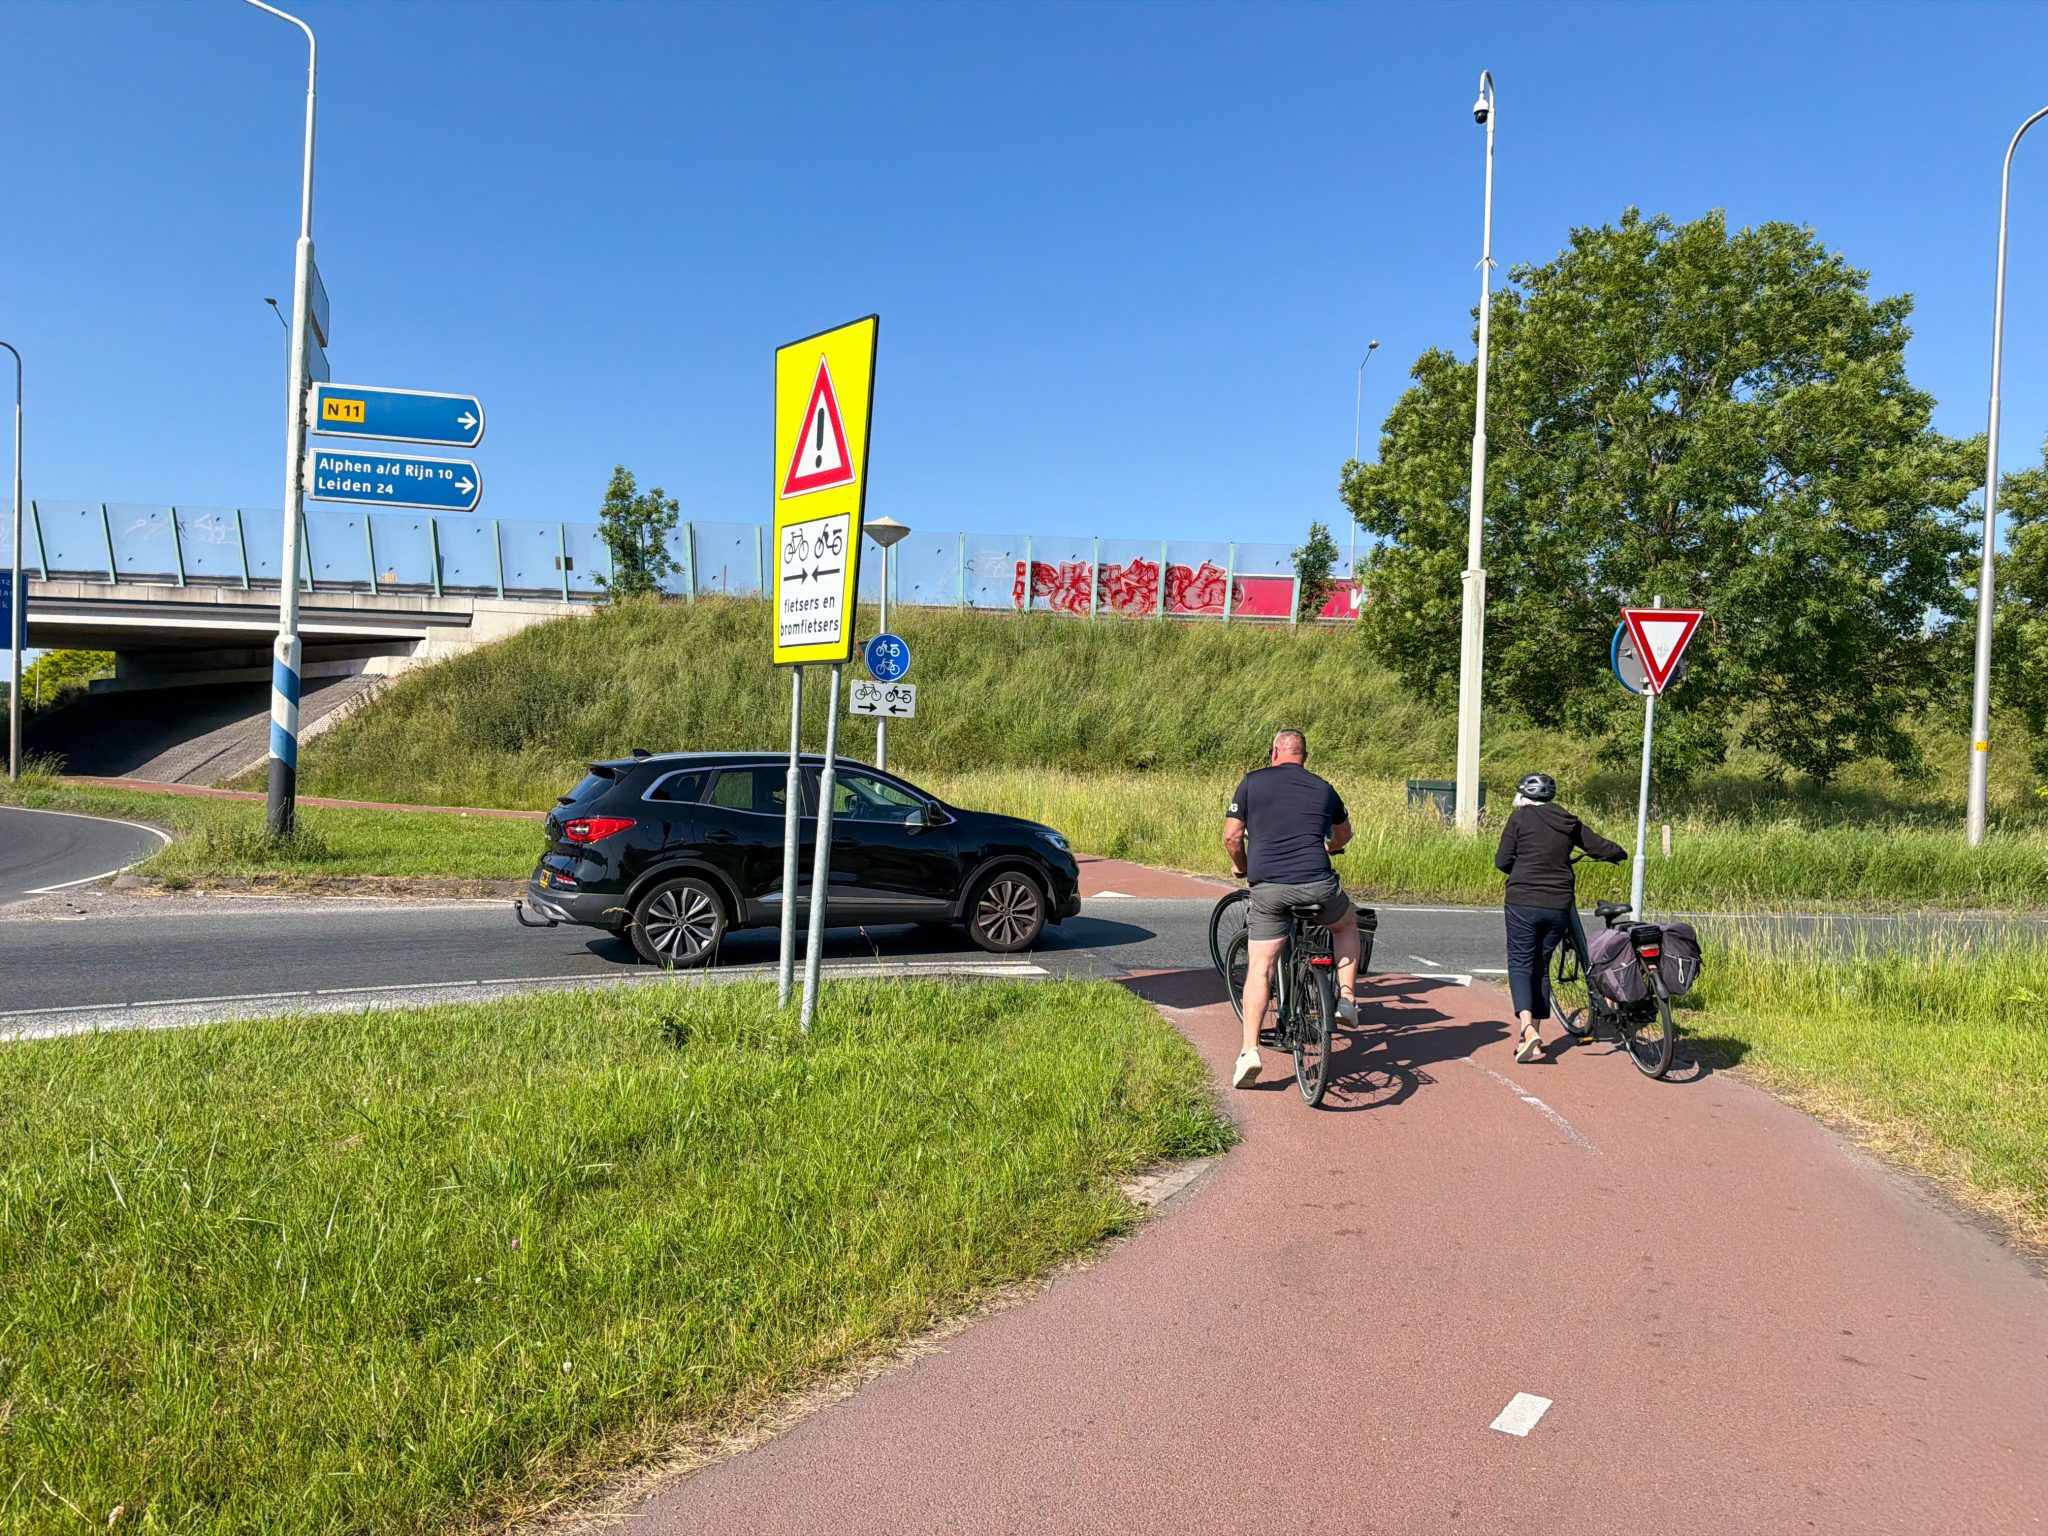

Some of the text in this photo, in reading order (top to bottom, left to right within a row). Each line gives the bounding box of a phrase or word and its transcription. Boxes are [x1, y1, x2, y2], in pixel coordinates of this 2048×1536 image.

[328, 403, 360, 418] N 11
[319, 457, 453, 480] Alphen a/d Rijn 10
[318, 477, 393, 494] Leiden 24
[784, 596, 835, 614] fietsers en
[780, 618, 839, 637] bromfietsers
